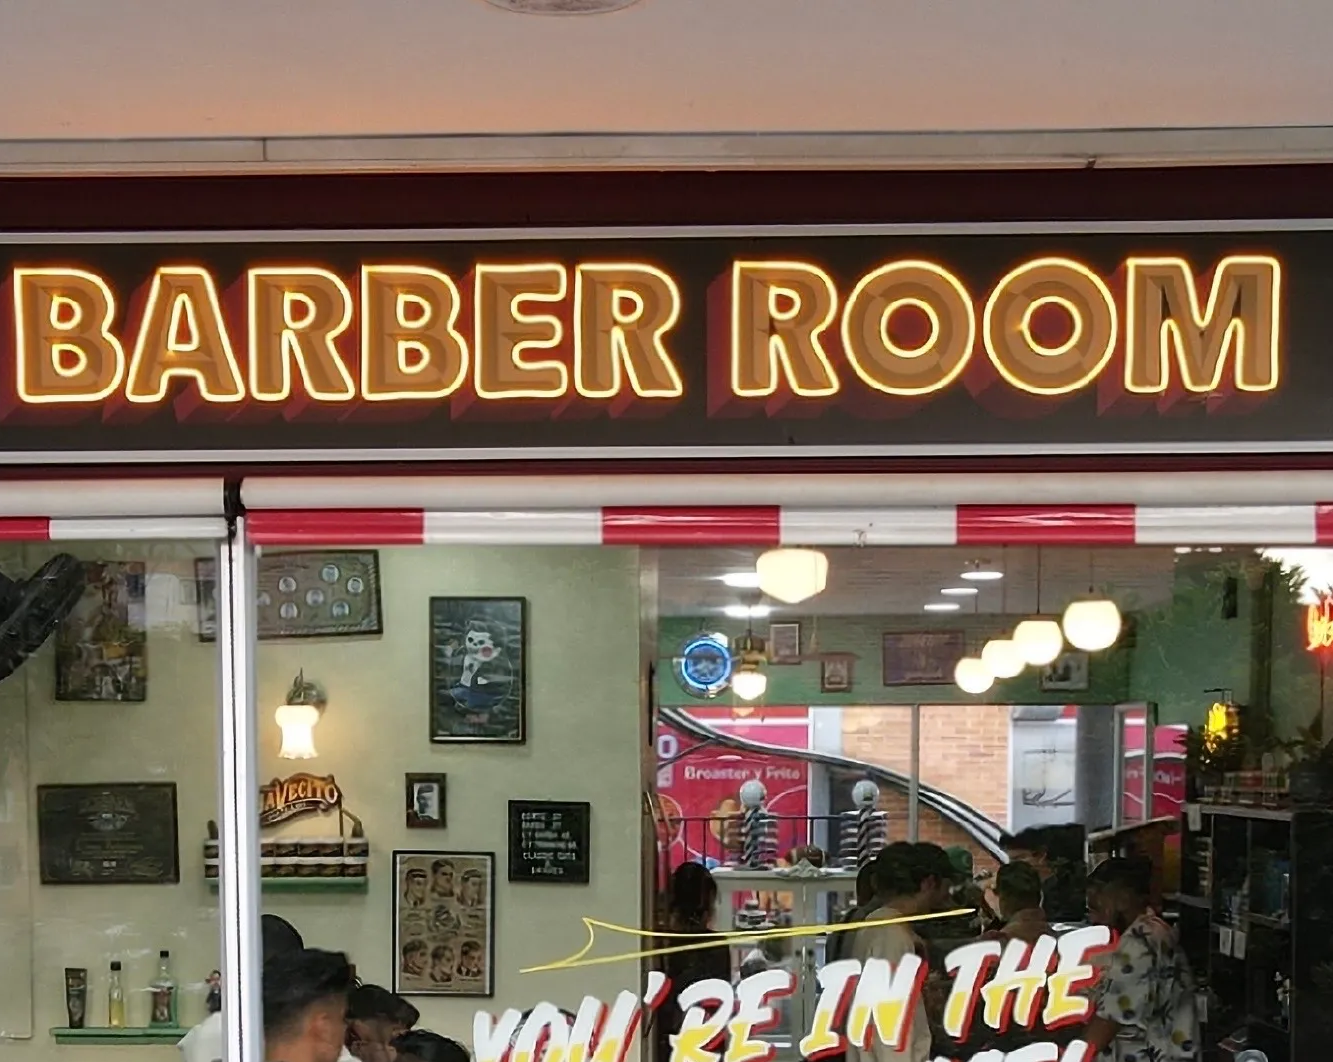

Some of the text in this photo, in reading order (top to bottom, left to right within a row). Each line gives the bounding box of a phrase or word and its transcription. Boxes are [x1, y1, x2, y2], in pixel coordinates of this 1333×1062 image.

[8, 255, 1282, 408] BARBER ROOM
[684, 765, 800, 781] Broaster y Frito
[800, 953, 927, 1059] IN
[942, 926, 1118, 1045] THE
